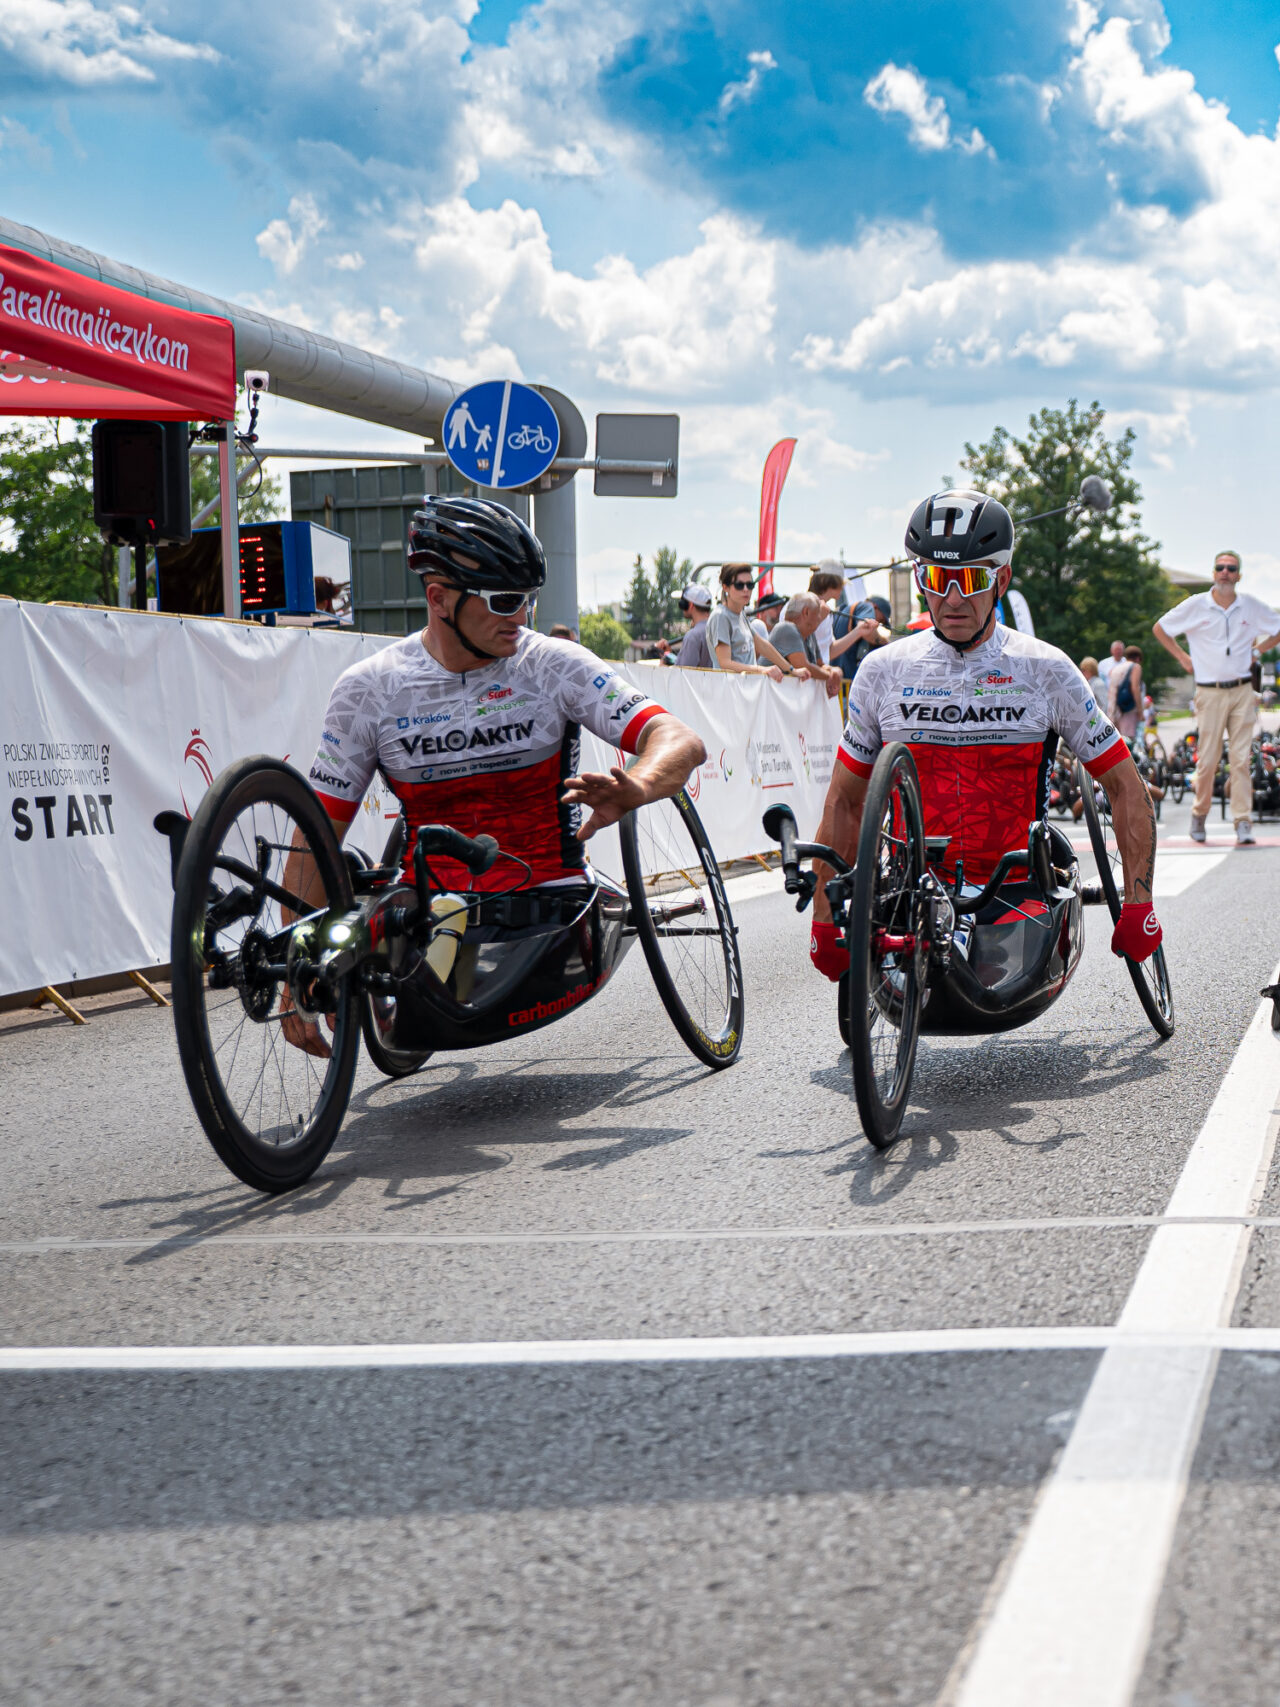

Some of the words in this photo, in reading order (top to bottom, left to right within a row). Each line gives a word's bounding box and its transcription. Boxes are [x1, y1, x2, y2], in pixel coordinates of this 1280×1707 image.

[0, 272, 189, 371] aralimpijczykom
[933, 550, 960, 560] uvex
[988, 675, 1012, 684] Start
[488, 687, 512, 701] Start
[916, 687, 952, 696] Kraków
[413, 713, 451, 725] Kraków
[929, 734, 956, 742] nowa
[4, 744, 37, 761] POLSKI
[102, 744, 110, 784] 1952
[440, 765, 467, 776] nowa
[12, 794, 115, 842] START
